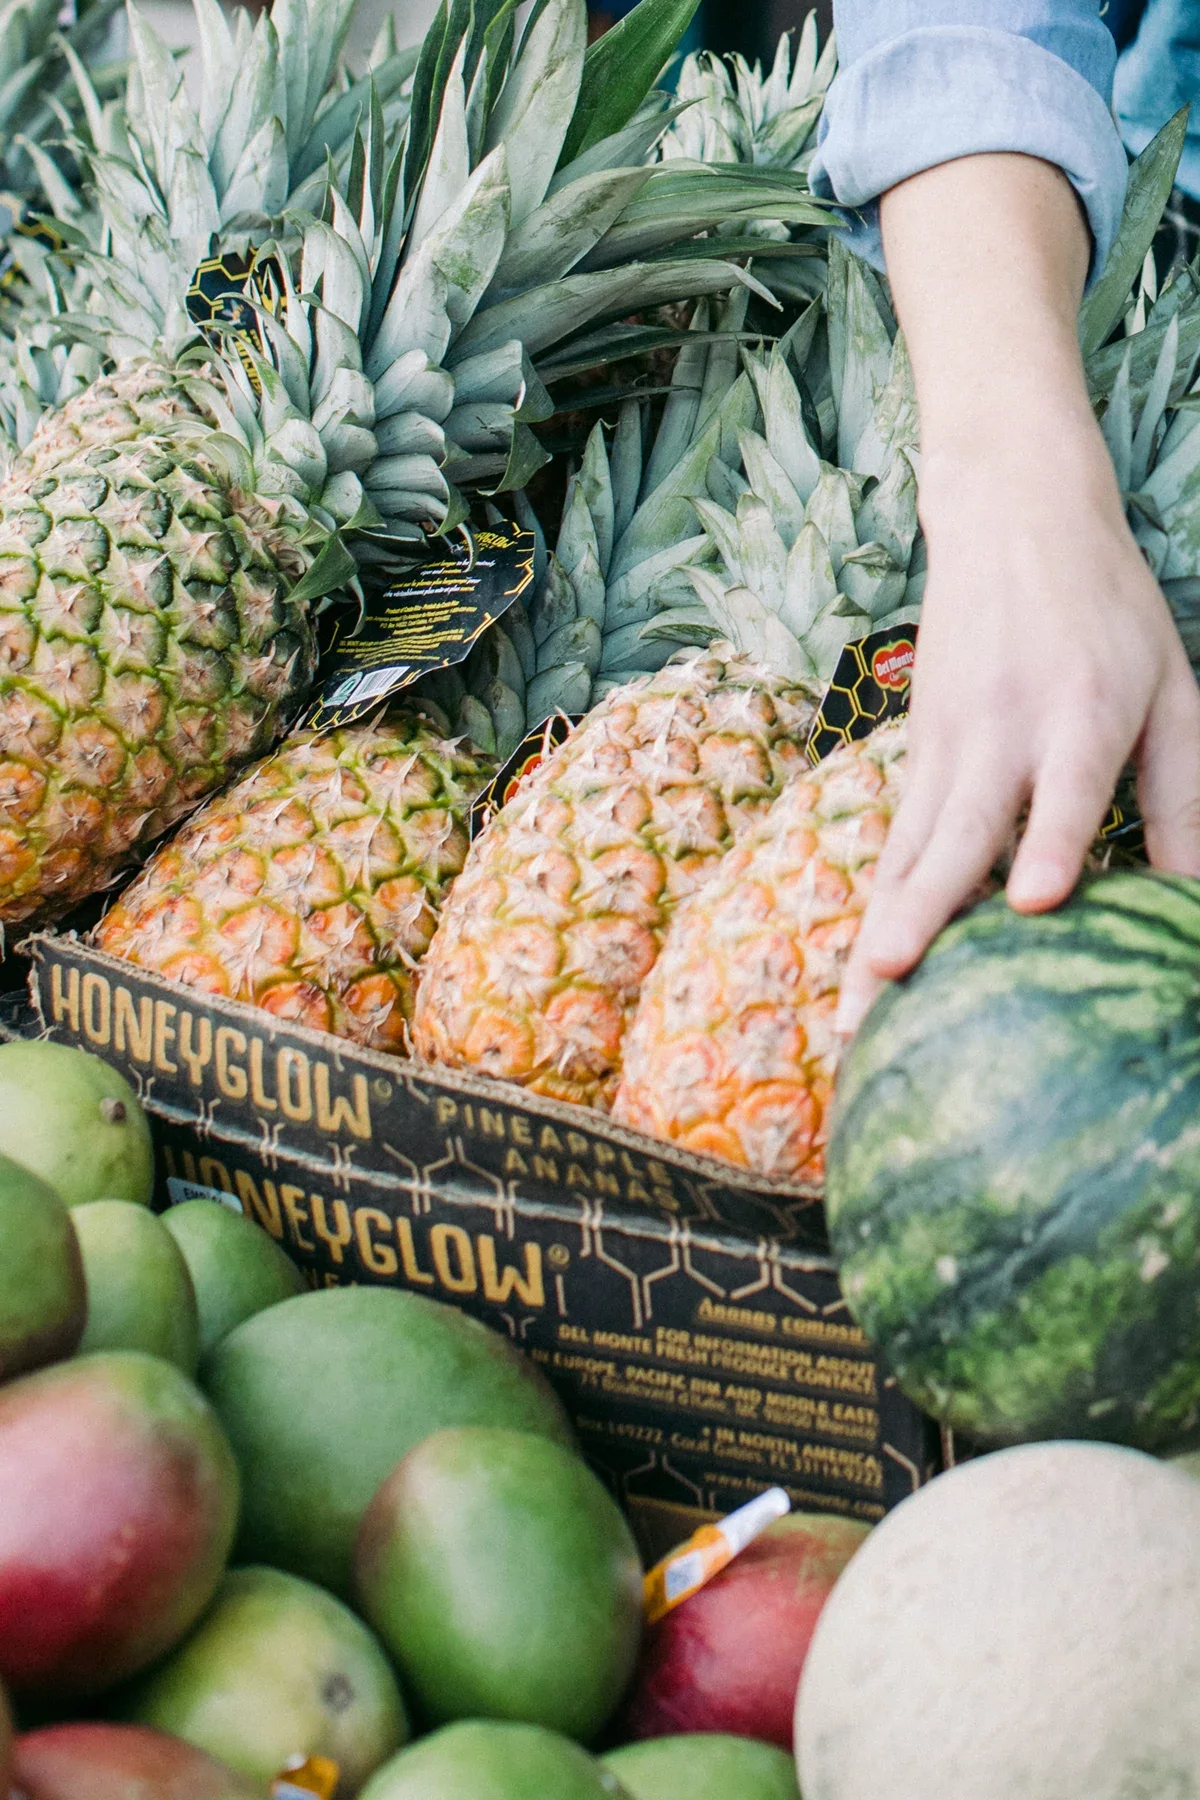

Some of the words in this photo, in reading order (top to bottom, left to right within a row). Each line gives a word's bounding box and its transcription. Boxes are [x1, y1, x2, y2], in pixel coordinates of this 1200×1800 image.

[51, 963, 373, 1140] HONEYGLOW
[437, 1094, 673, 1188] PINEAPPLE
[504, 1147, 681, 1211] ANANAS
[697, 1297, 777, 1329] Ananas
[781, 1315, 869, 1344] comosu
[557, 1323, 590, 1344] DEL
[592, 1329, 652, 1354] MONTE
[655, 1340, 708, 1366] FRESH
[710, 1352, 789, 1381] PRODUCE
[655, 1325, 691, 1346] FOR
[693, 1334, 813, 1368] INFORMATION
[815, 1354, 877, 1378] ABOUT
[625, 1364, 687, 1390] PACIFIC
[689, 1376, 722, 1397] RIM
[724, 1383, 762, 1405] AND
[765, 1390, 830, 1417] MIDDLE
[738, 1431, 799, 1455] NORTH
